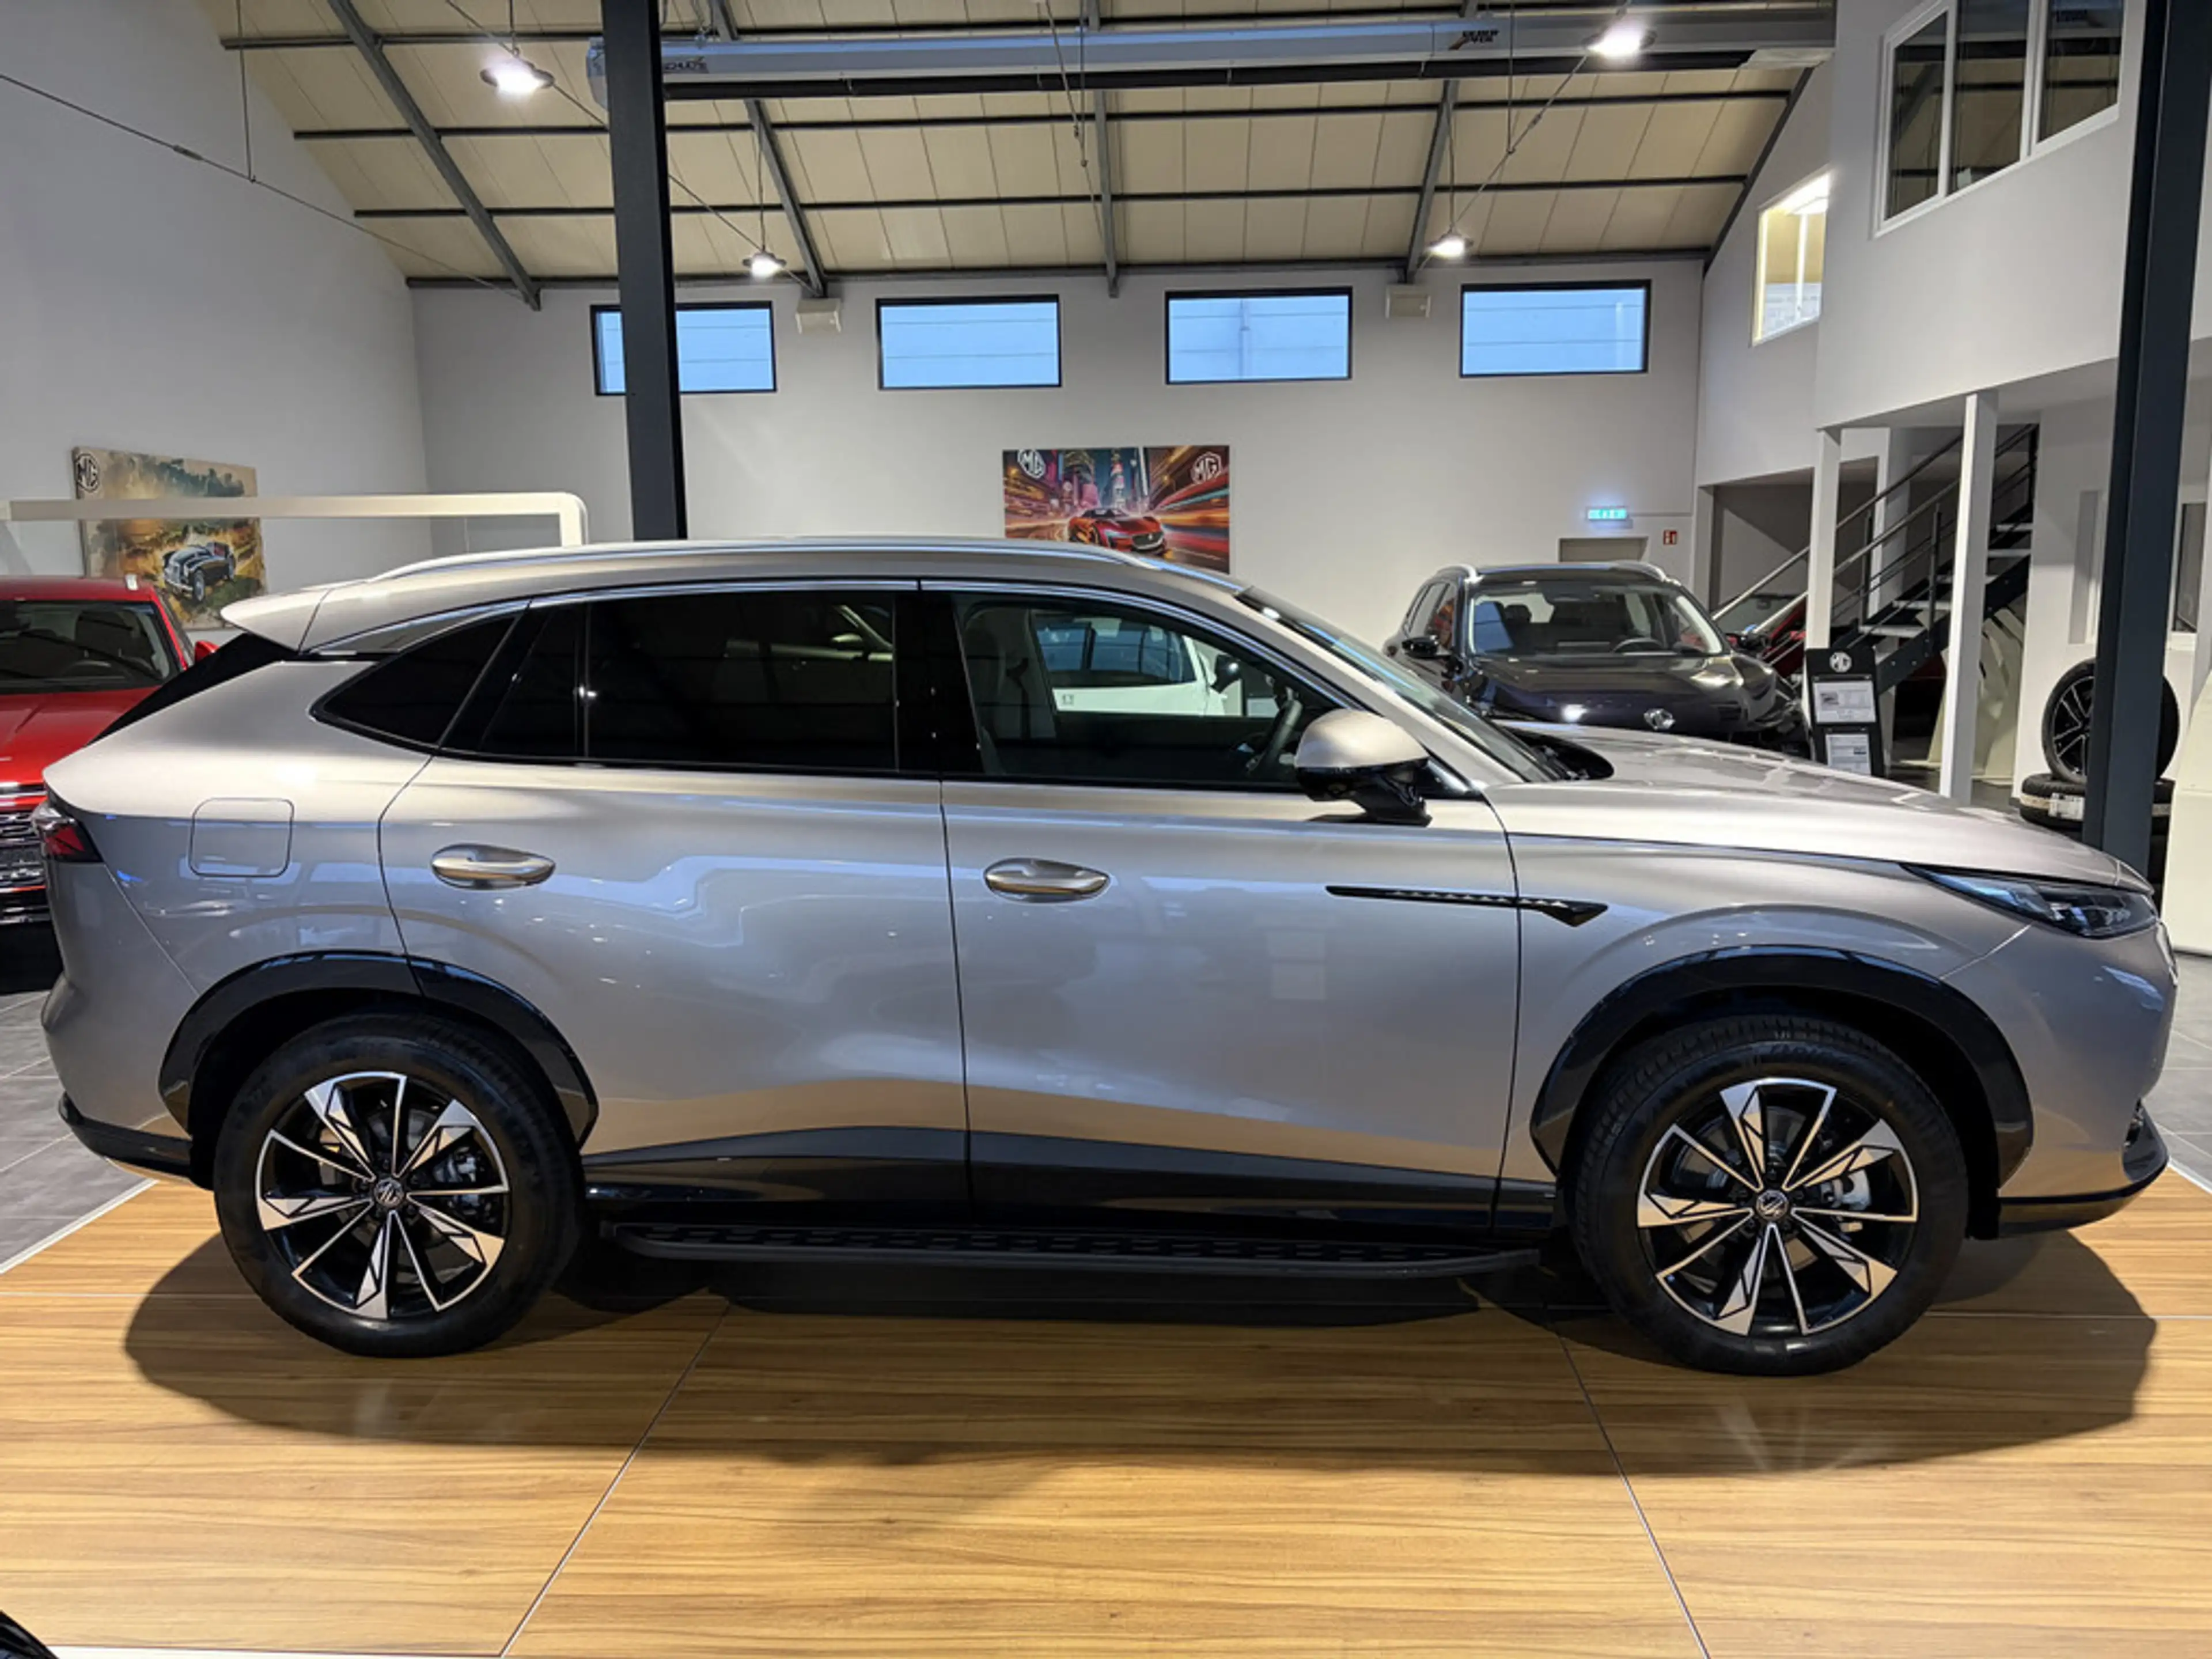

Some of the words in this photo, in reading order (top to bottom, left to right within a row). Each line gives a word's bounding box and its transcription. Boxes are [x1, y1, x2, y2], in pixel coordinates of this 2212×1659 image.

[77, 457, 97, 488] MG
[1019, 450, 1044, 476] MG
[1194, 456, 1218, 482] MG
